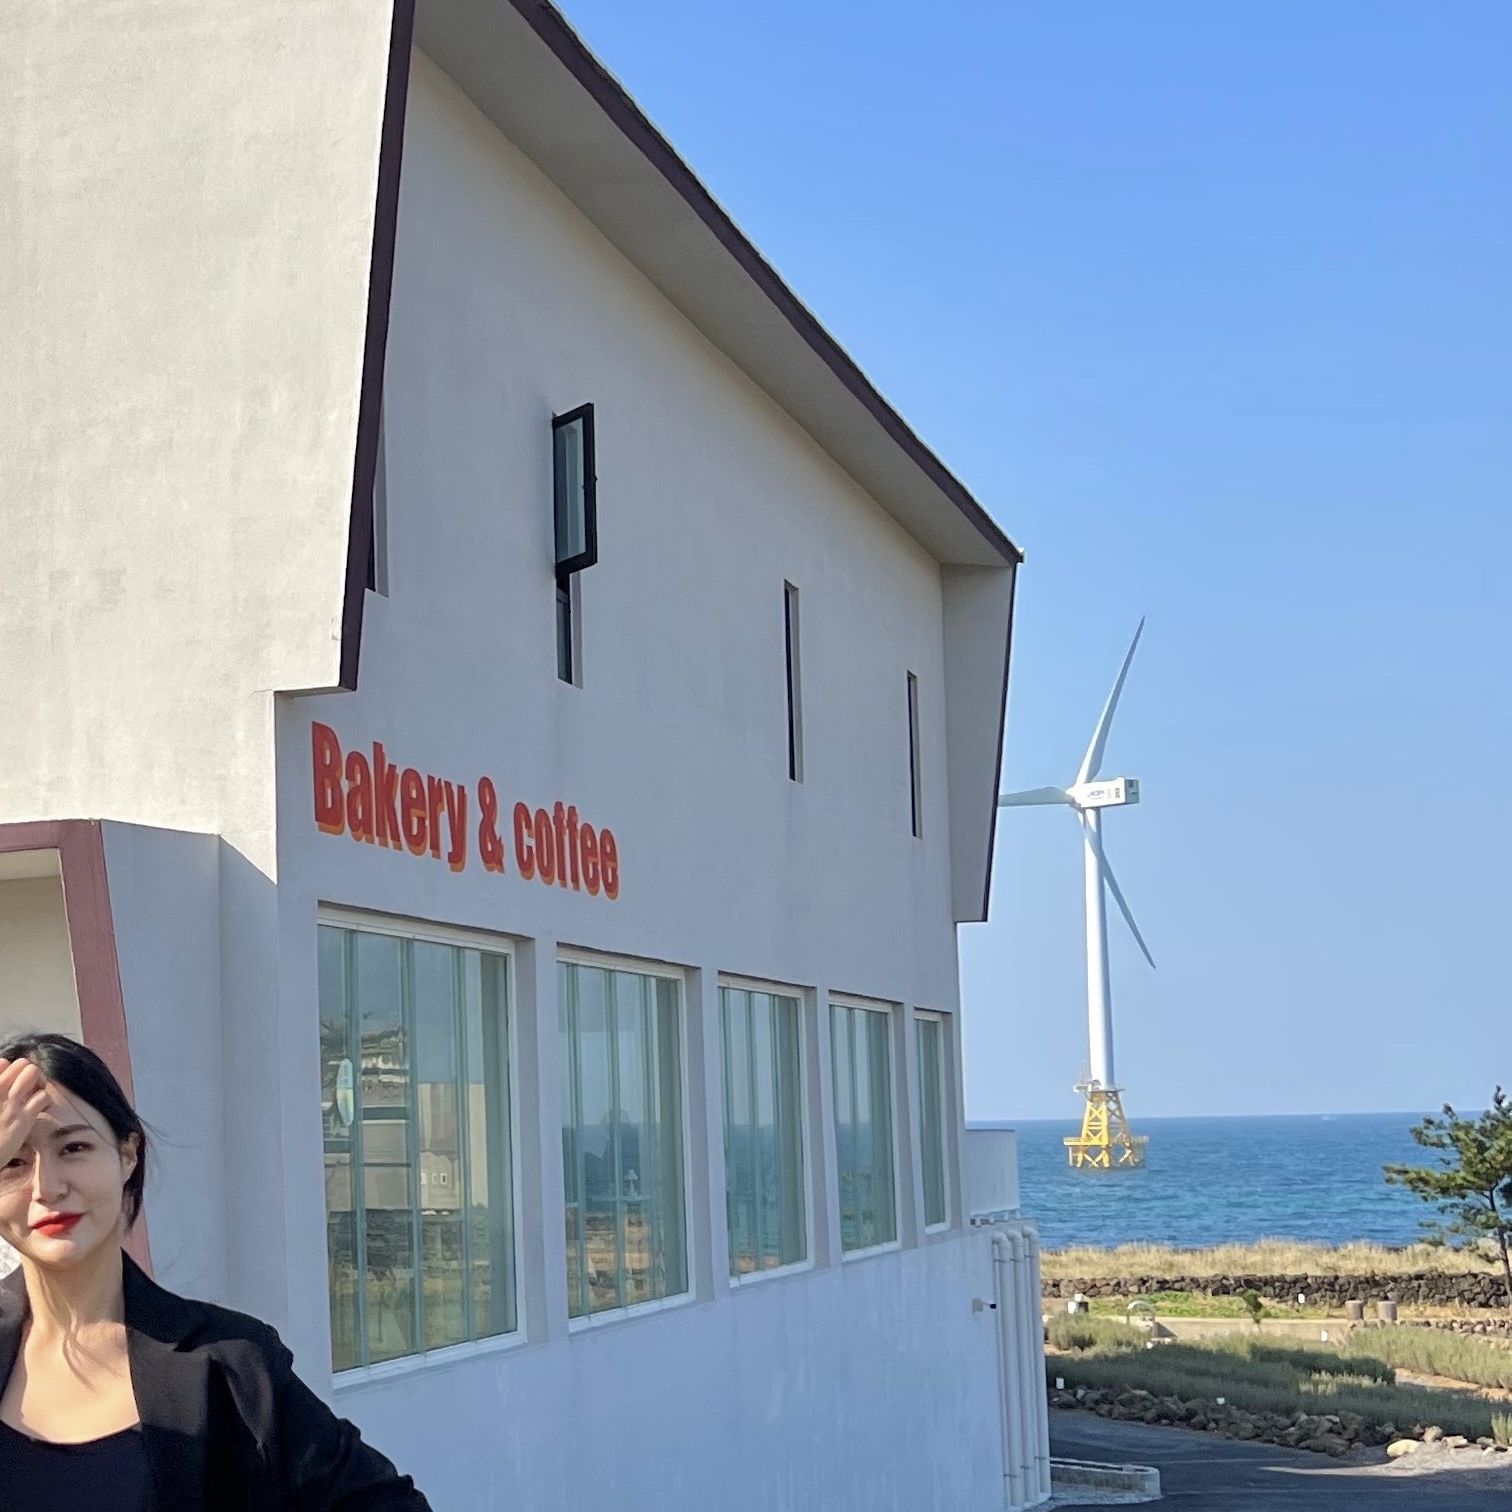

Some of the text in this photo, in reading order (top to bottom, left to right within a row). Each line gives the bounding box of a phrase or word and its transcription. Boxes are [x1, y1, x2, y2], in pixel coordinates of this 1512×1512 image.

[311, 720, 620, 901] Bakery & coffee
